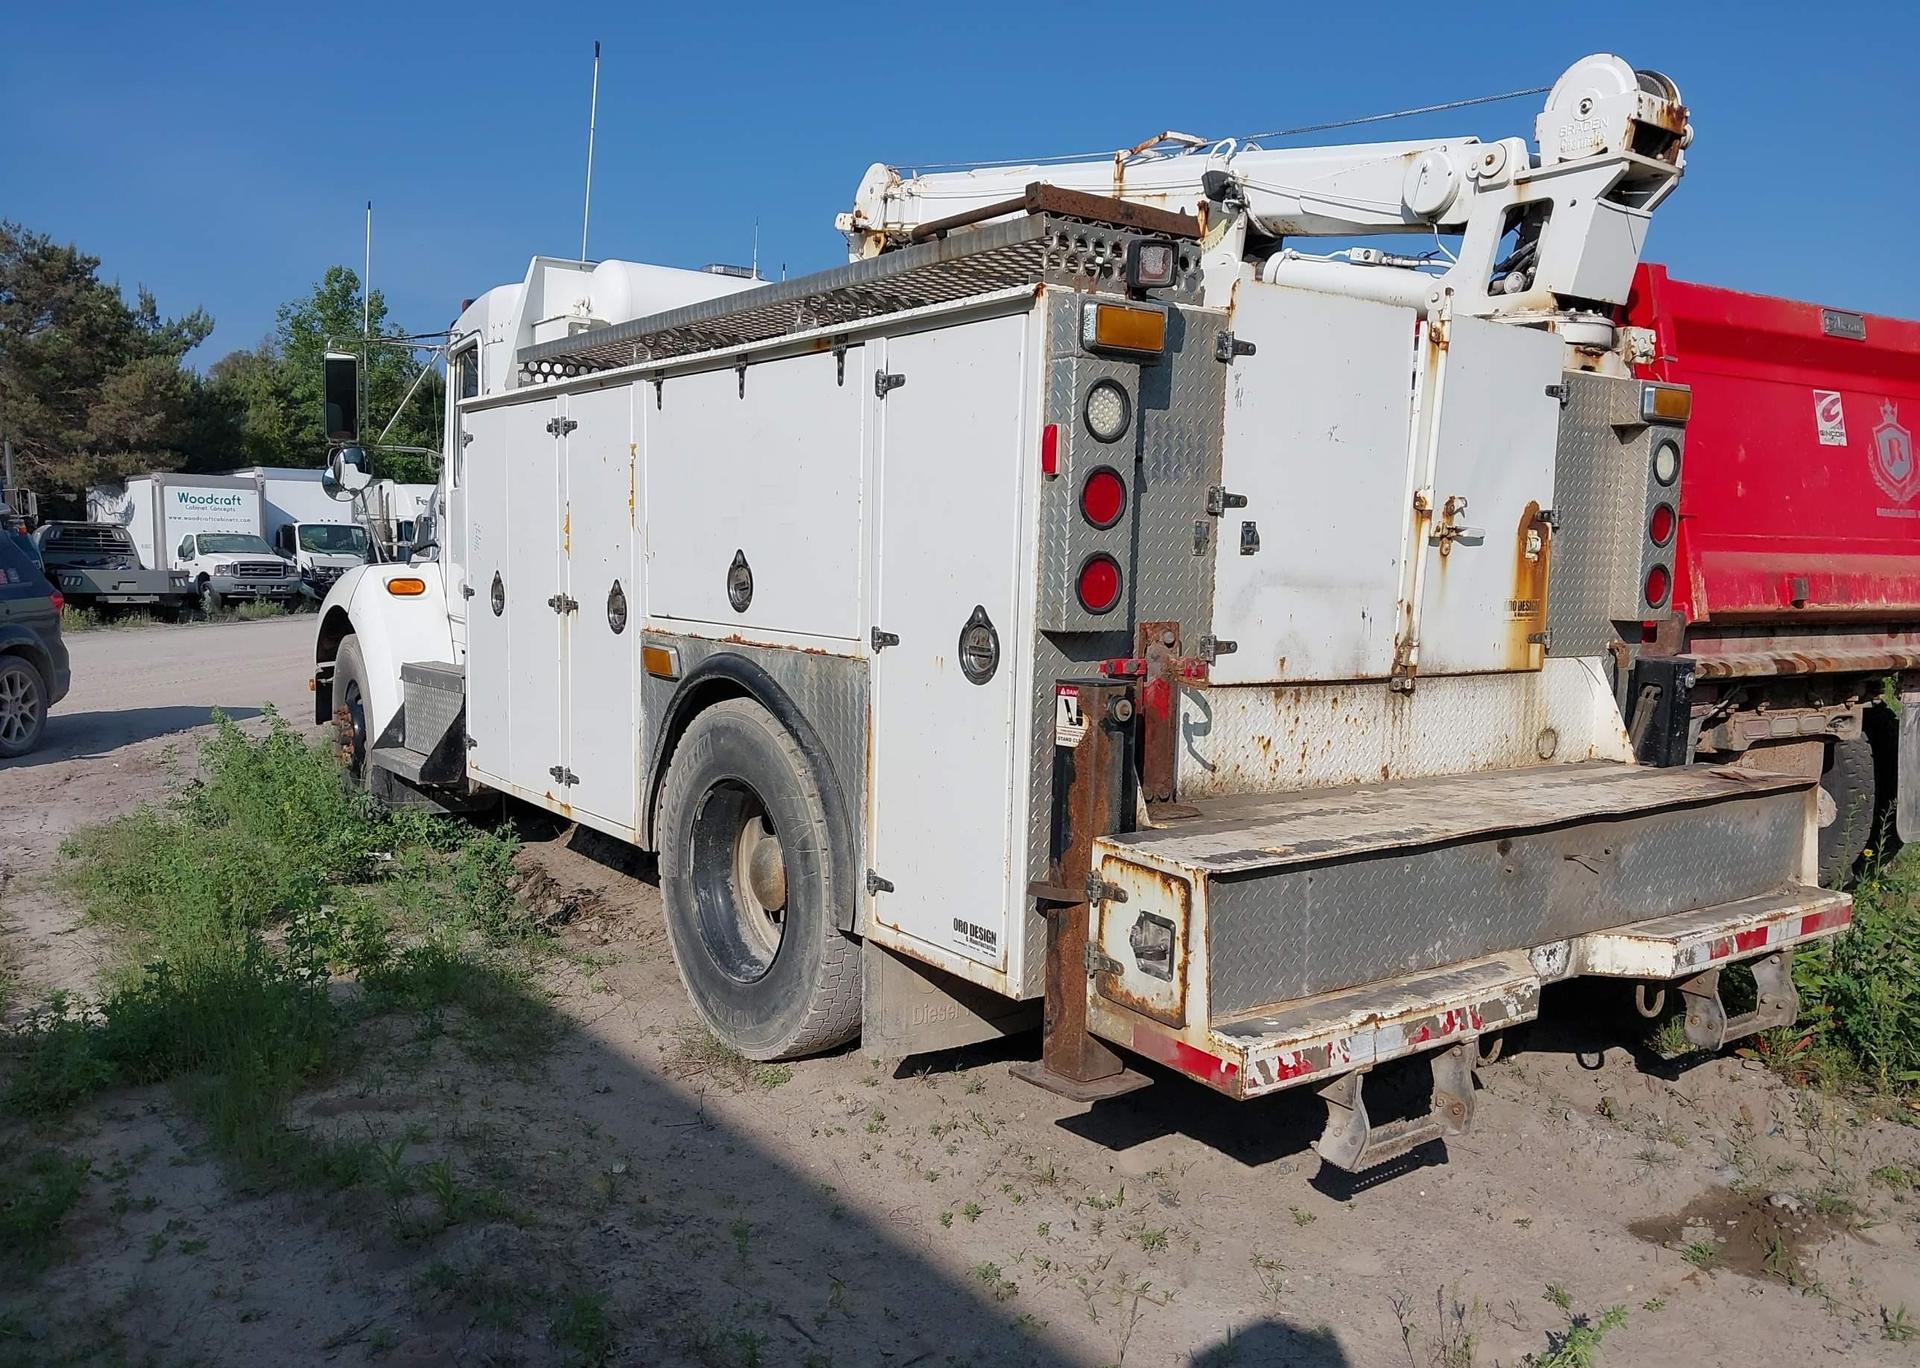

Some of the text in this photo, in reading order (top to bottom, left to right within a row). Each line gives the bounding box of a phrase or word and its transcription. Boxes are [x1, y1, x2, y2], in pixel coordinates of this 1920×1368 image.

[1559, 119, 1608, 138] BRADEN
[177, 491, 242, 506] Woodcraft
[209, 505, 236, 513] Concepts
[1066, 688, 1079, 696] DAN
[953, 917, 997, 946] ORO DESIGN
[913, 1002, 960, 1026] Diesel
